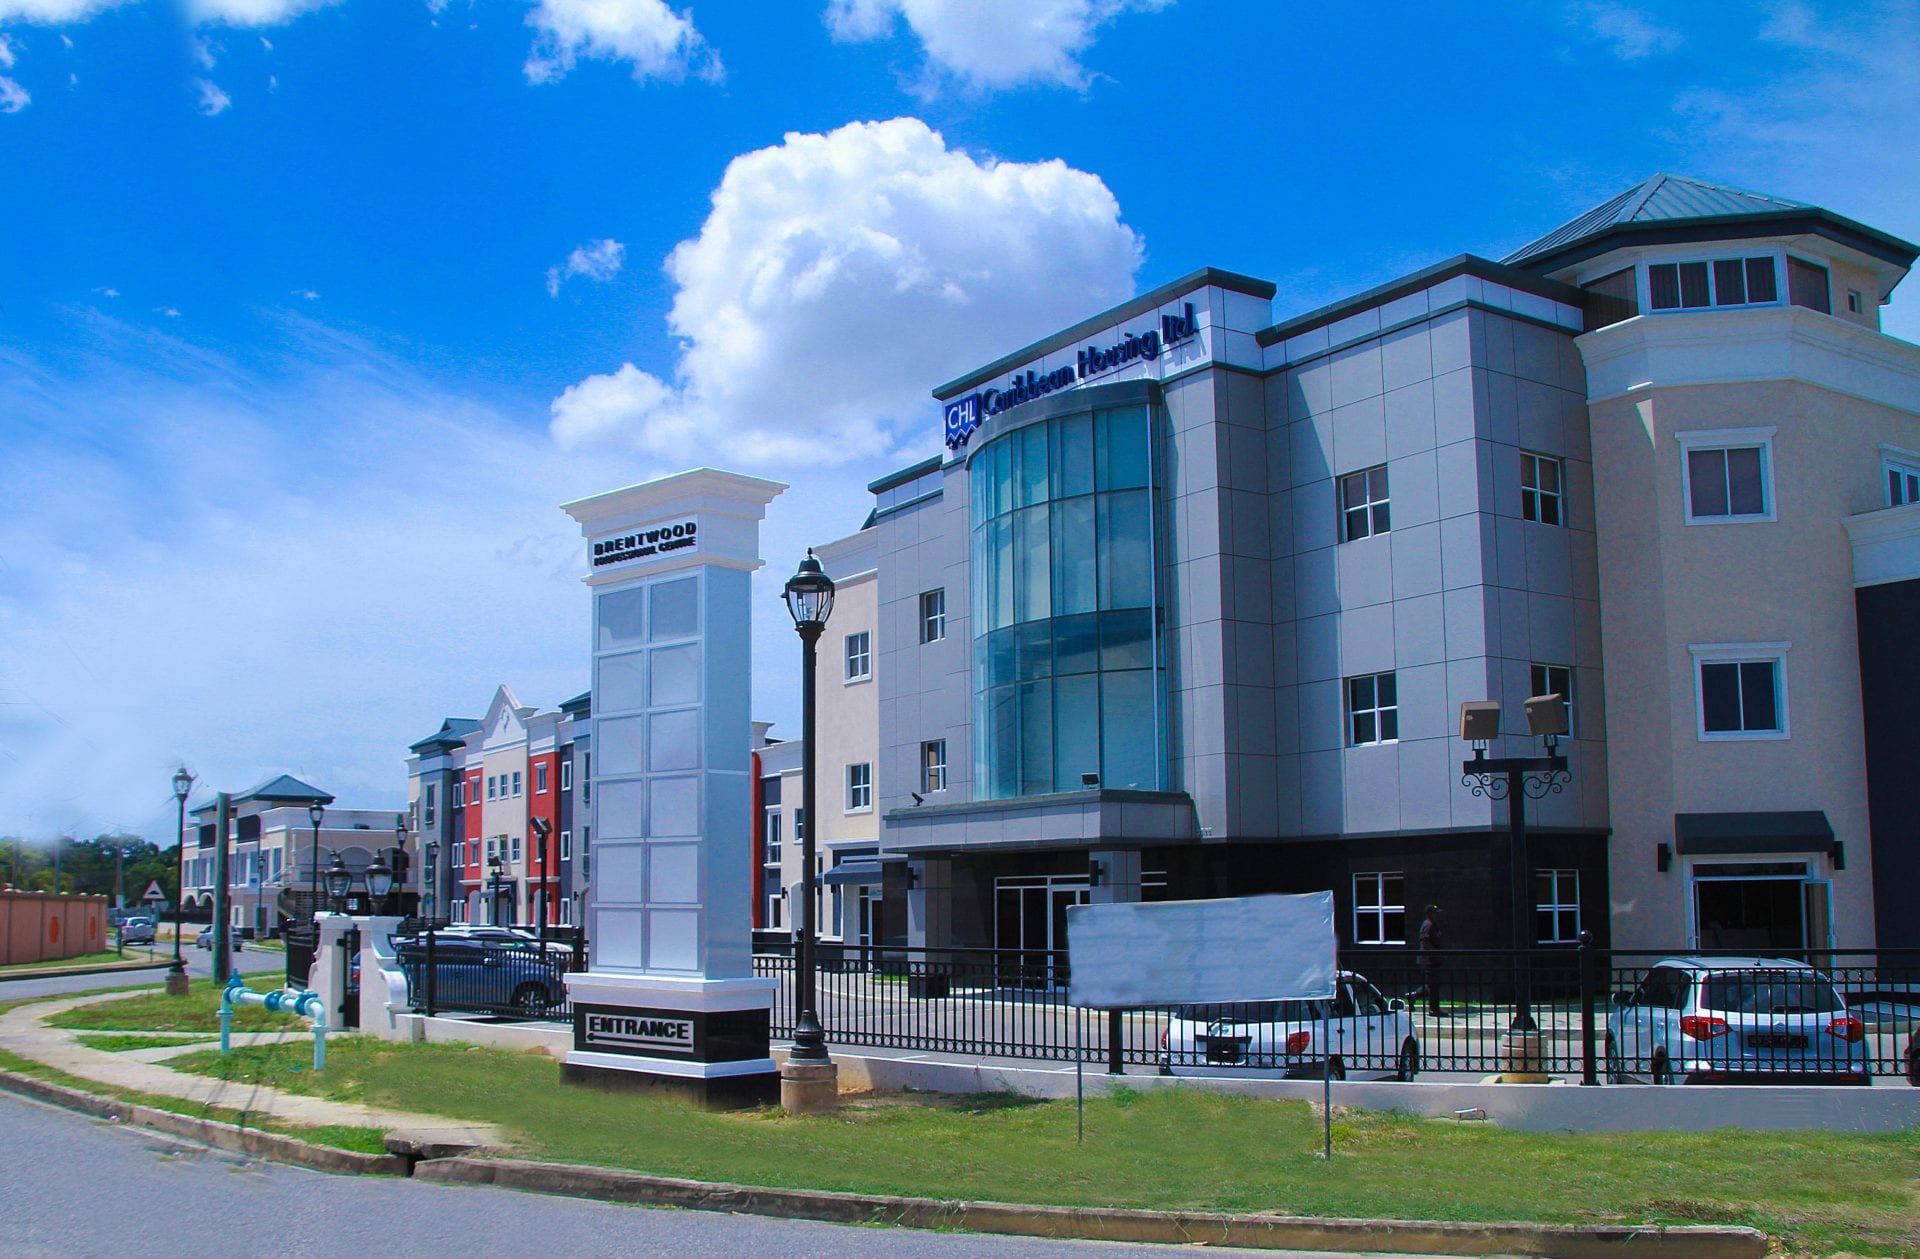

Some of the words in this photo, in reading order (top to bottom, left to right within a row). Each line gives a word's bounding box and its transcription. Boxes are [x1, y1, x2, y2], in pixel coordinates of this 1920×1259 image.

[983, 365, 1076, 416] Caribbean
[1077, 331, 1159, 379] Housing
[948, 400, 976, 429] CHL
[593, 522, 697, 556] BRENTWOOD
[589, 1016, 689, 1040] ENTRANCE
